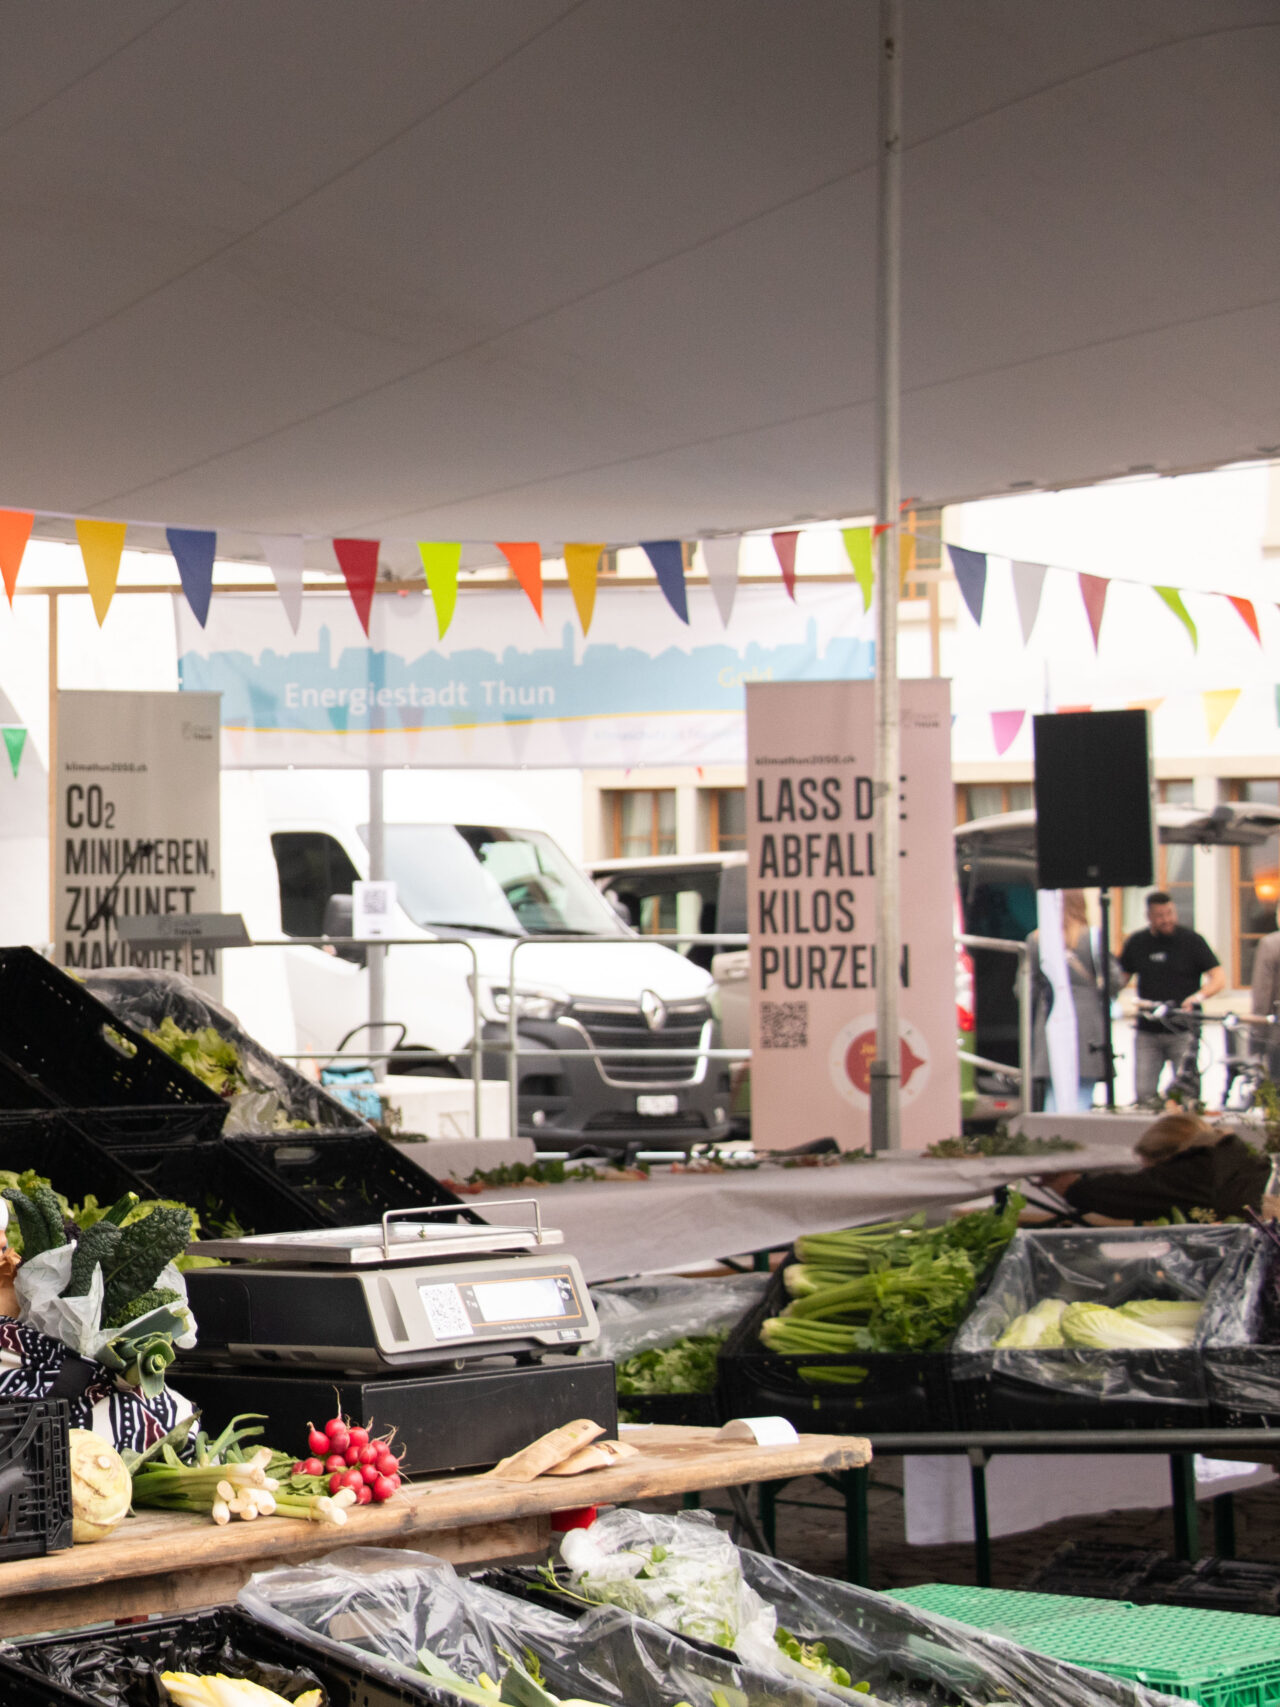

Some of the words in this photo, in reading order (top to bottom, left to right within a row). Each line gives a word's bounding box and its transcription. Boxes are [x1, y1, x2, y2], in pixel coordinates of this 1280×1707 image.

[284, 680, 468, 715] Energiestadt
[480, 680, 555, 705] Thun
[66, 783, 115, 829] CO2
[756, 777, 841, 822] LASS
[65, 838, 216, 879] MINIMIEREN,
[759, 888, 855, 934] KILOS
